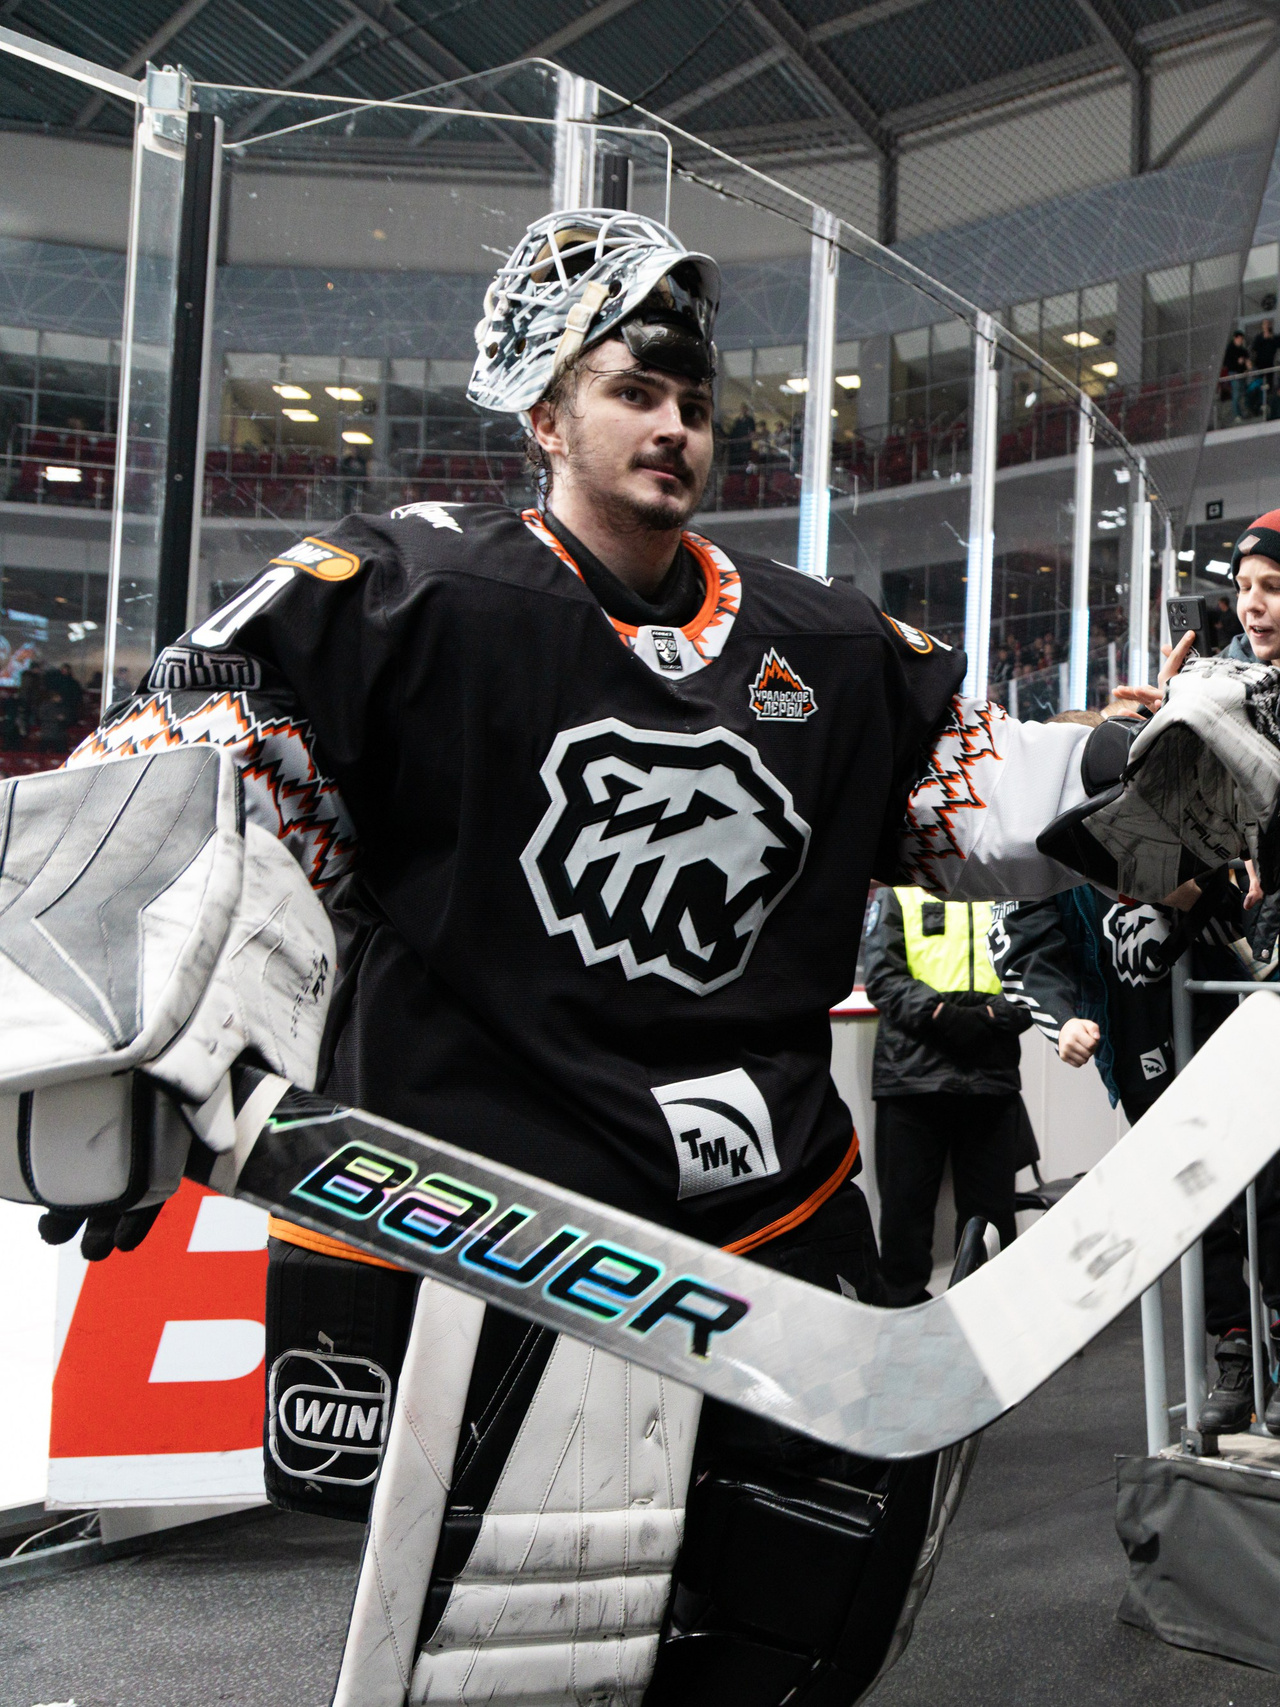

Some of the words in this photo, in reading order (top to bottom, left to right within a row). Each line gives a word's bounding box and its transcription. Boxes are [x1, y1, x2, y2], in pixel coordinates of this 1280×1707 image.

[176, 566, 296, 648] 0
[755, 689, 809, 702] УРАЛЬСКОЕ
[761, 701, 803, 718] ДЕРБИ
[1183, 808, 1231, 860] TRUE
[295, 1397, 379, 1441] WIN
